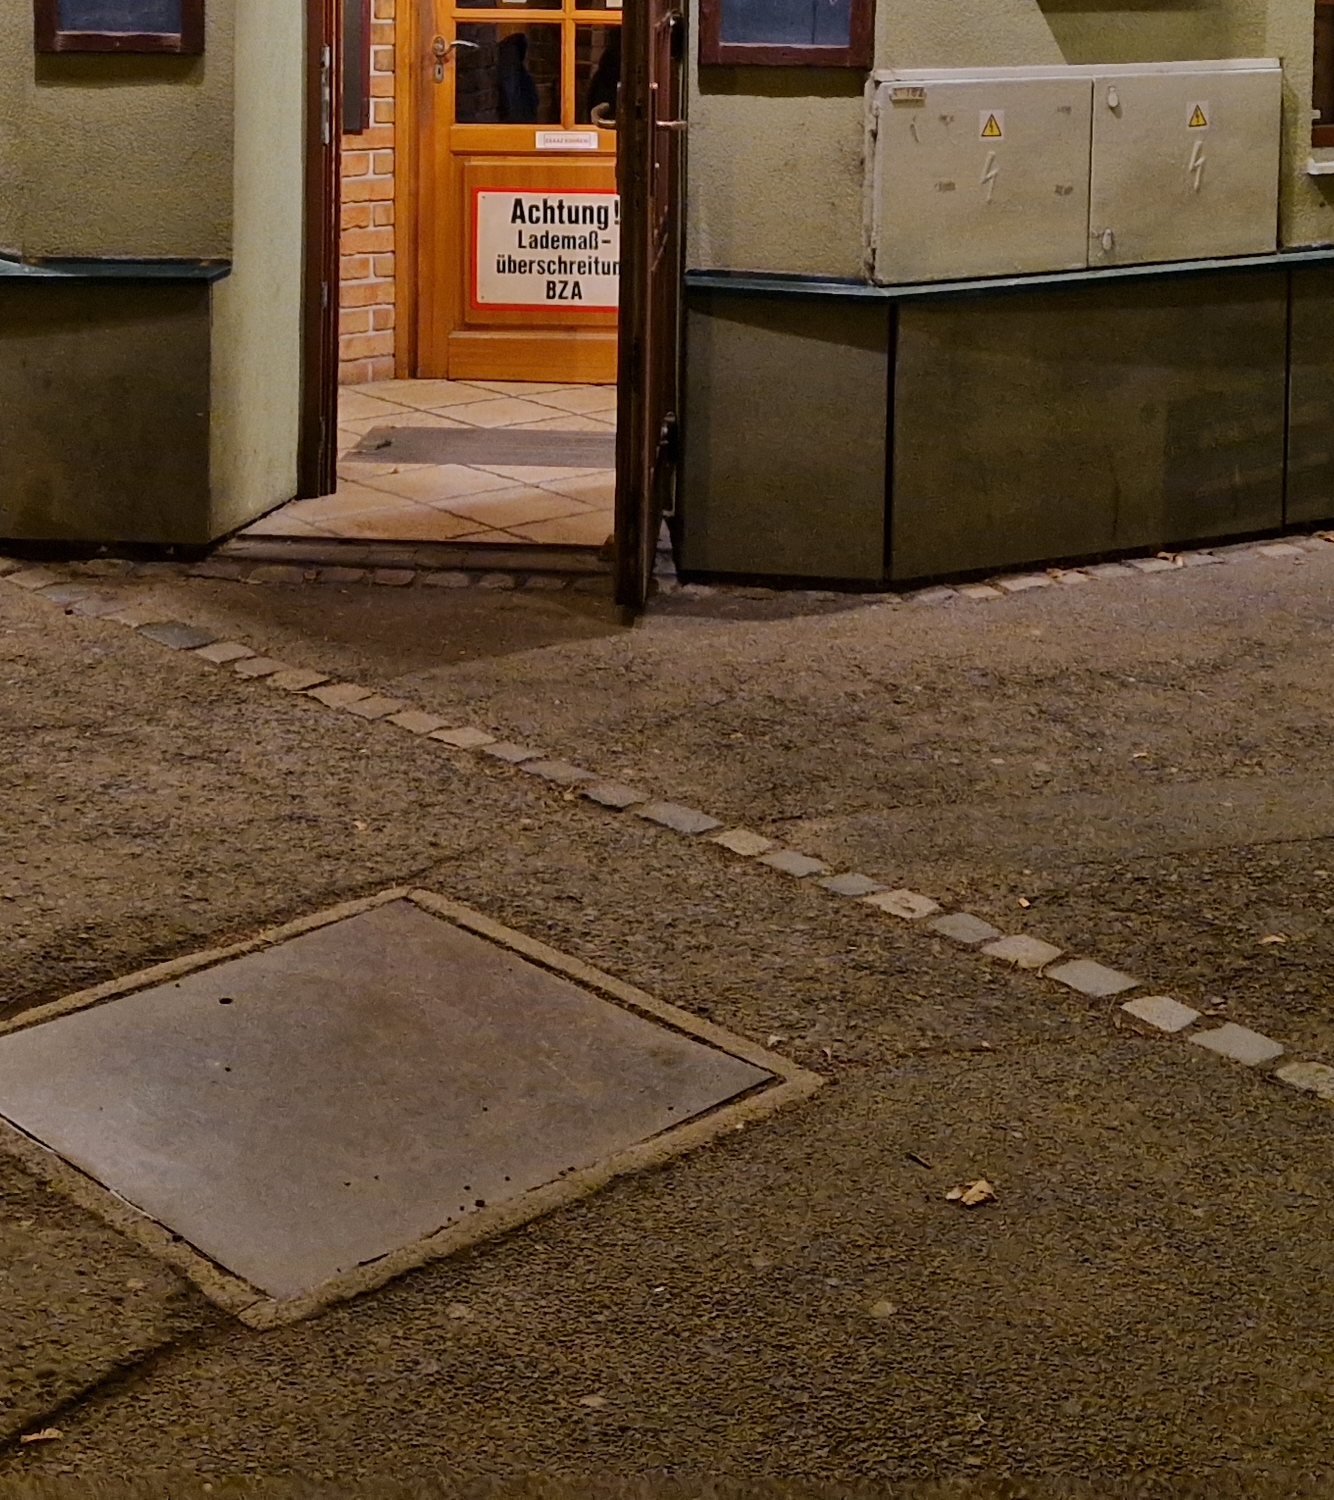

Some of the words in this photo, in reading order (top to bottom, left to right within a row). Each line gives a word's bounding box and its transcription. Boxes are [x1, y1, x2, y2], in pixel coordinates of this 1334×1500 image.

[517, 229, 611, 251] Lademaß-
[496, 253, 620, 276] überschreitun
[546, 280, 583, 300] BZA
